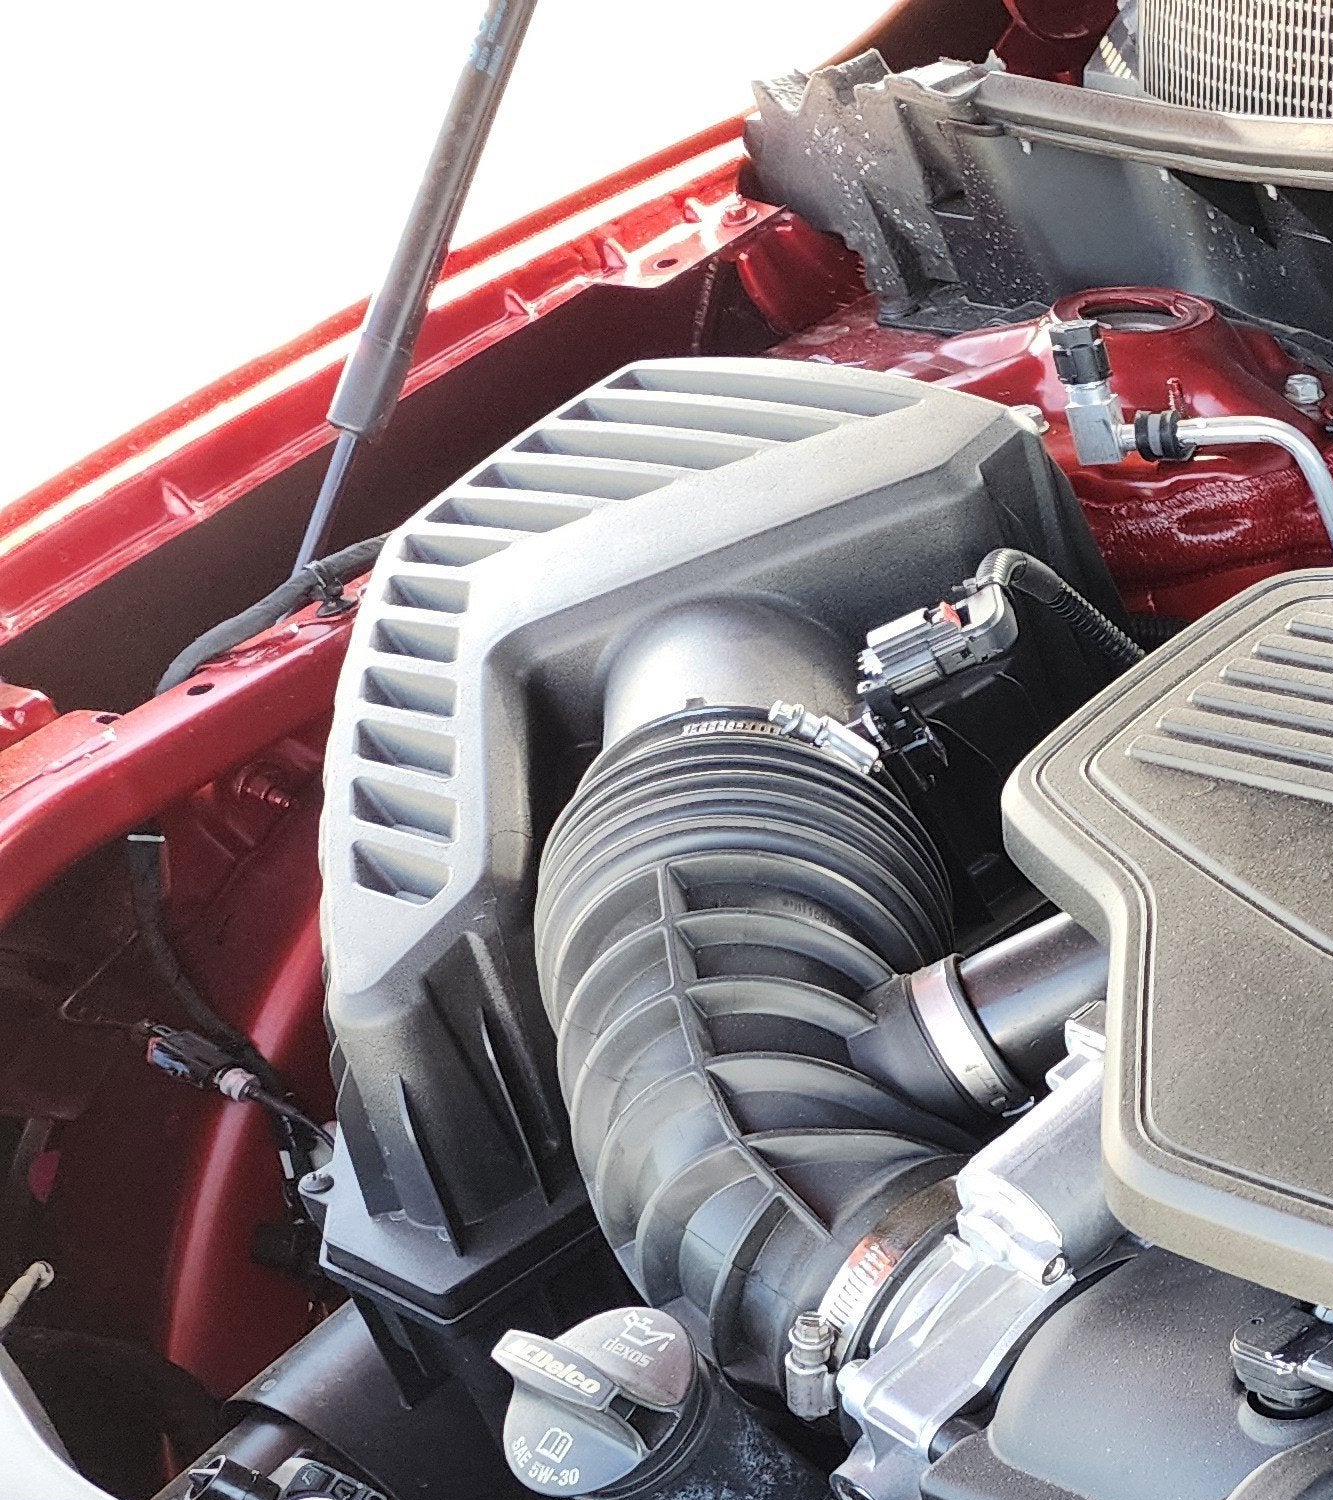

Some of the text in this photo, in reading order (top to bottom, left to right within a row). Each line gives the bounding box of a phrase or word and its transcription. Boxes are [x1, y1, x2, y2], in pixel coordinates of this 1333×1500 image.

[503, 1339, 602, 1396] ACDelco
[602, 1338, 655, 1367] dexos
[512, 1436, 581, 1487] SAE 5W-30
